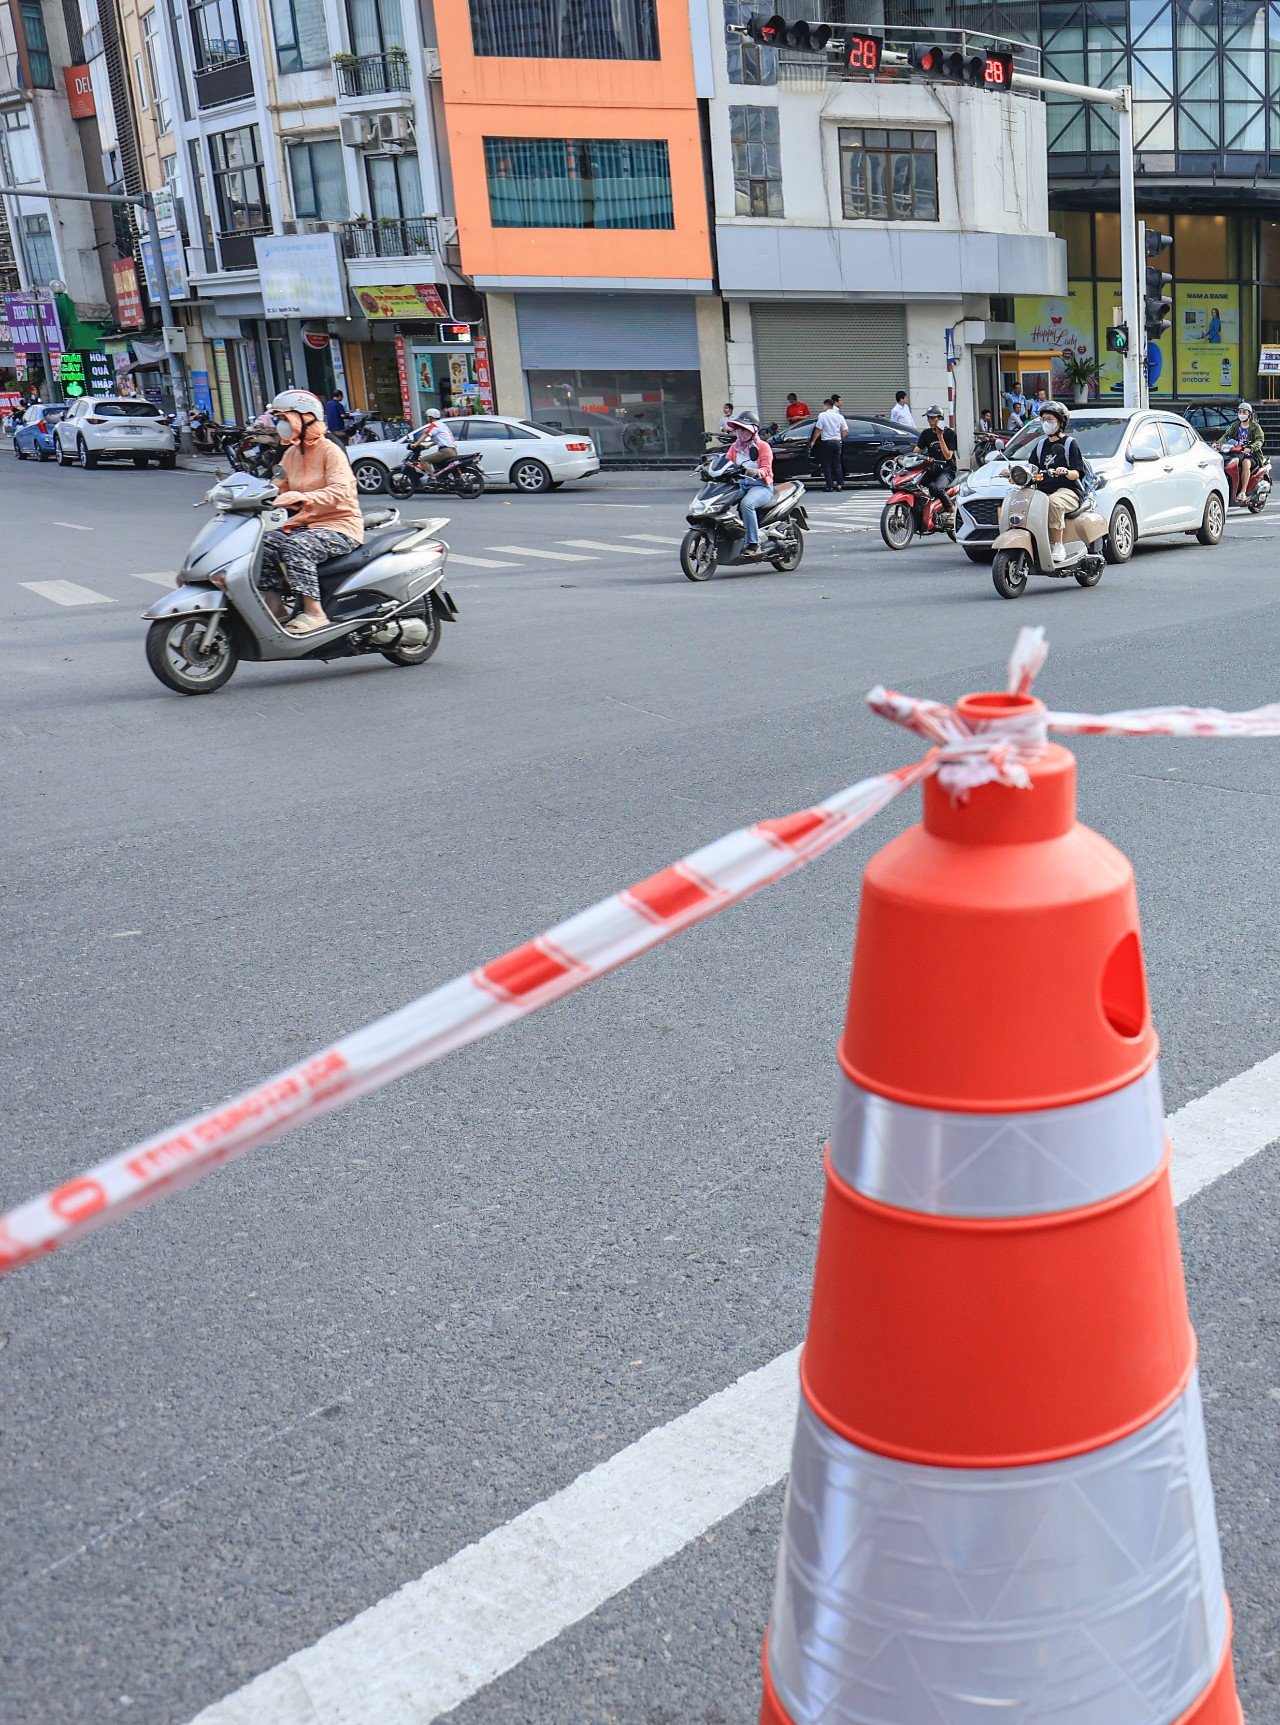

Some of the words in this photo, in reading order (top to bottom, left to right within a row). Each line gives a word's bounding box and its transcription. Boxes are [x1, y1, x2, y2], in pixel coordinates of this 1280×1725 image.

[849, 37, 877, 70] 28
[984, 59, 1004, 84] 28
[1030, 326, 1057, 343] Happy
